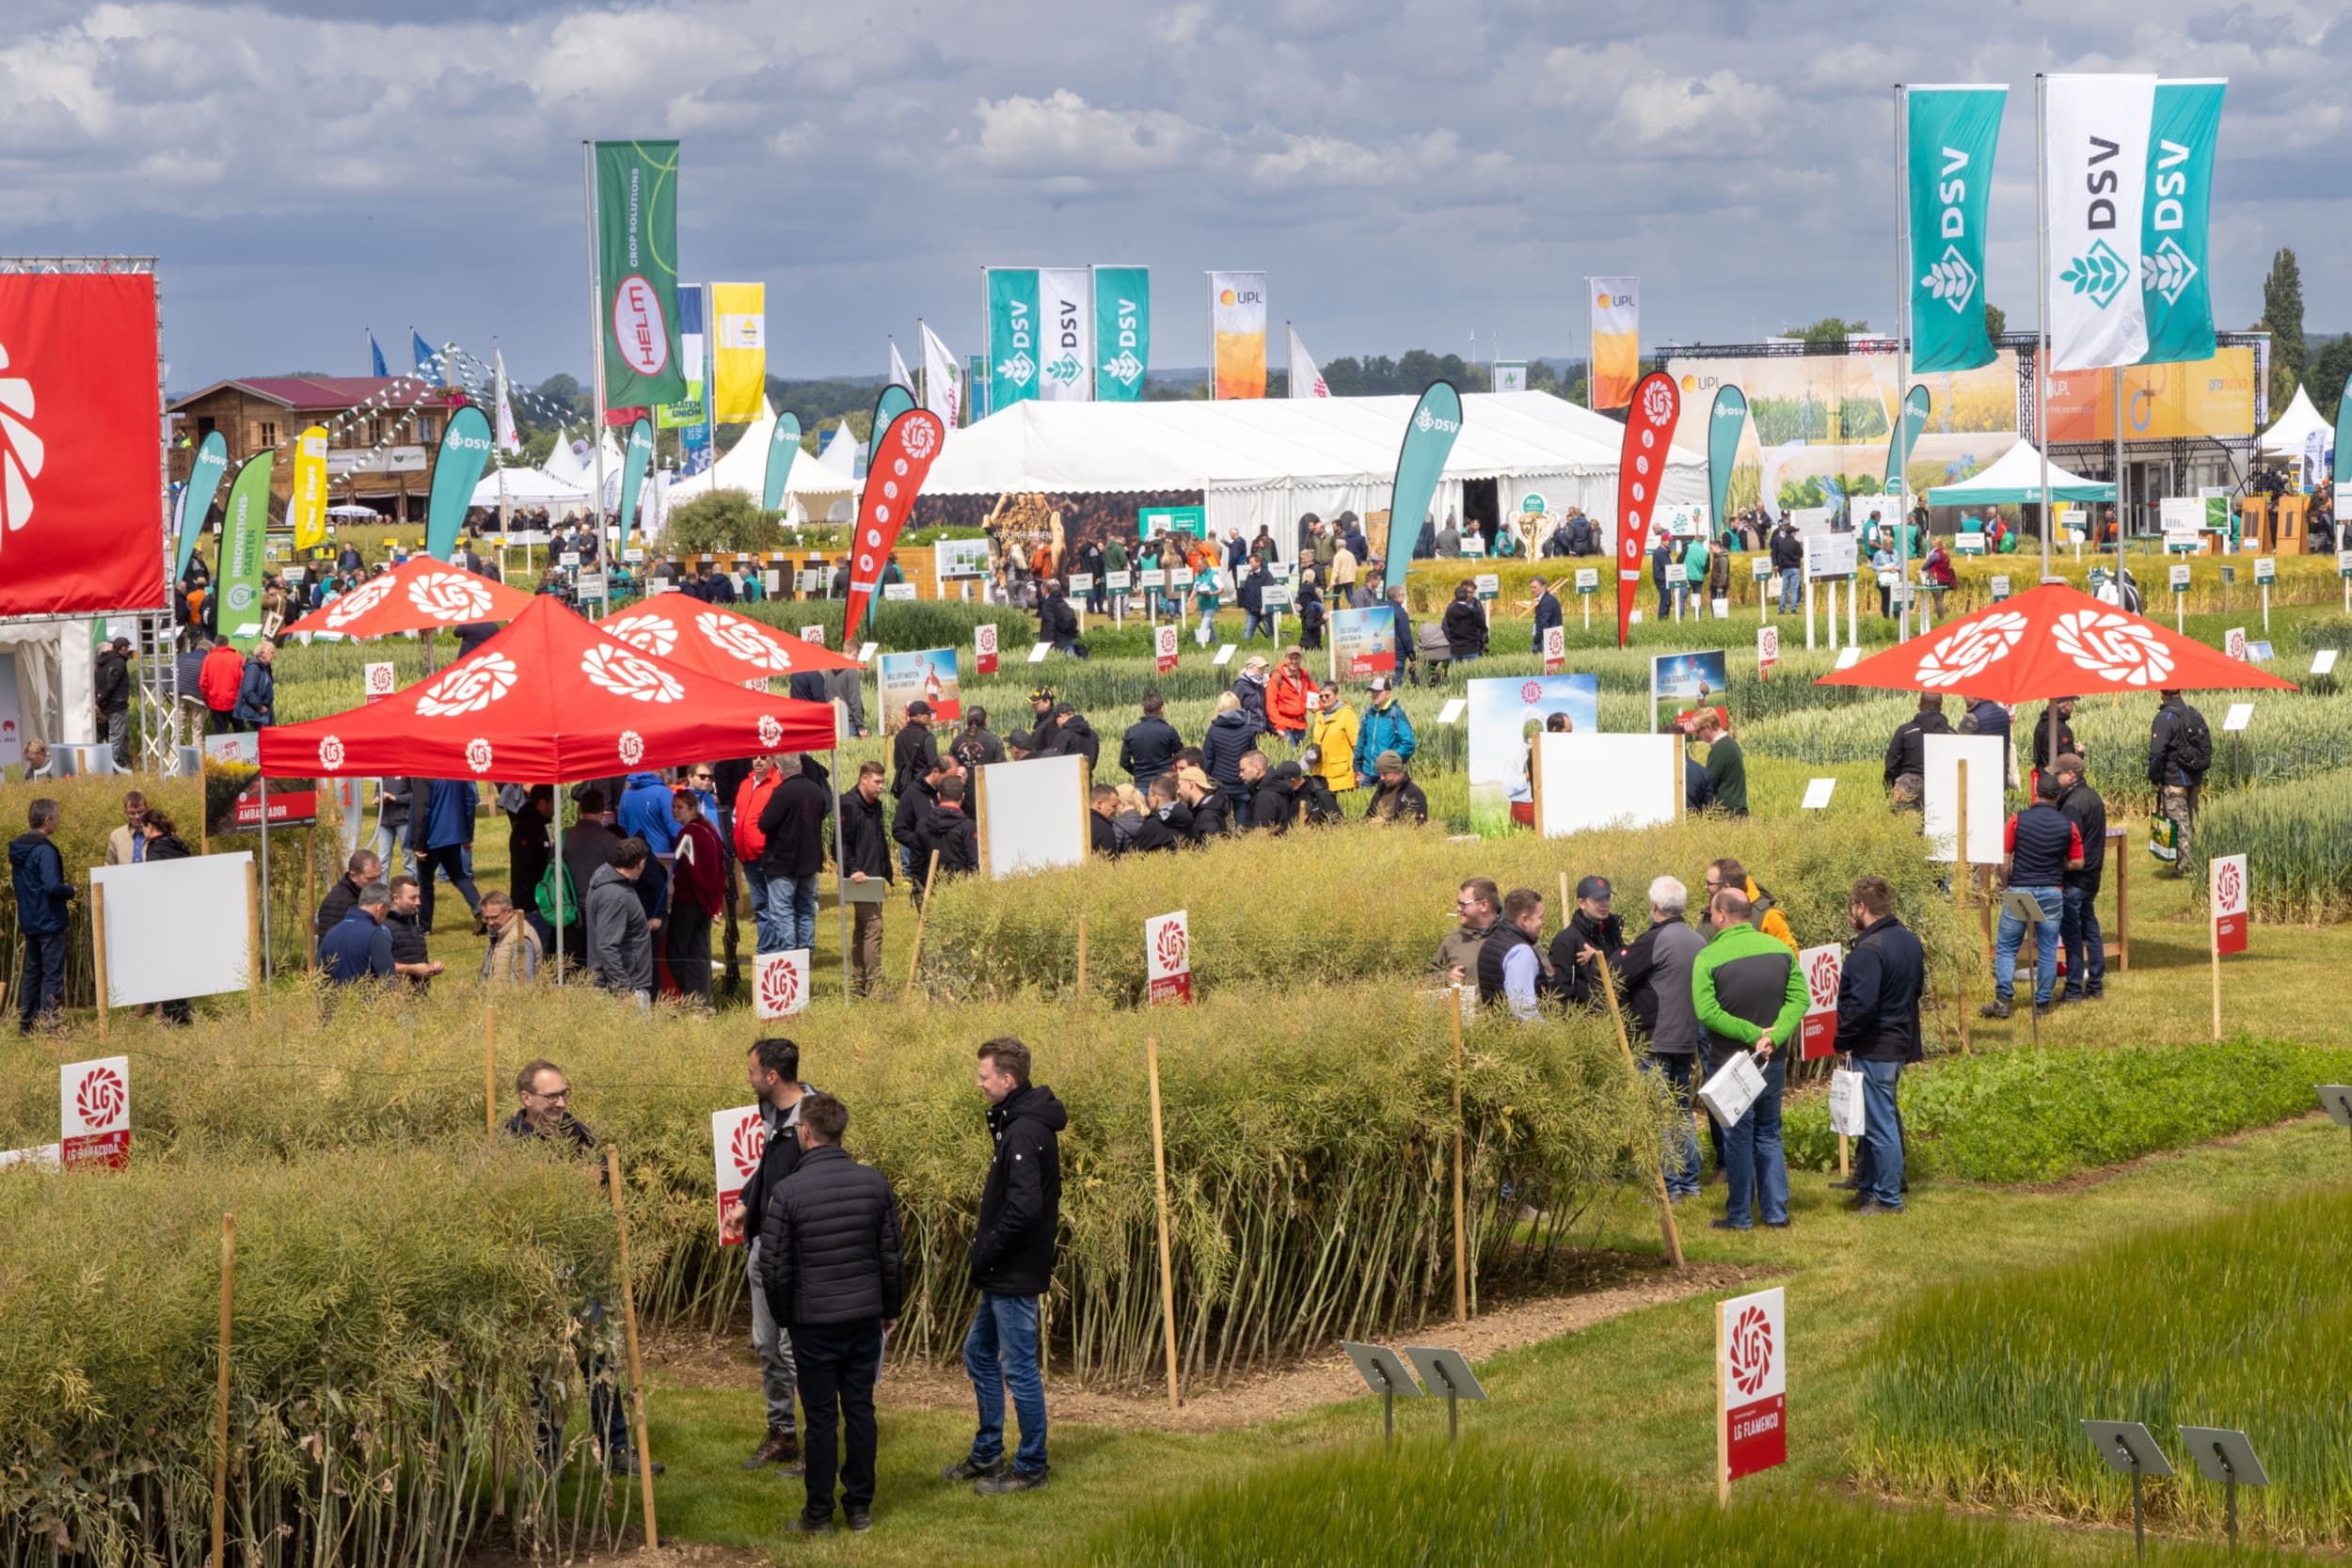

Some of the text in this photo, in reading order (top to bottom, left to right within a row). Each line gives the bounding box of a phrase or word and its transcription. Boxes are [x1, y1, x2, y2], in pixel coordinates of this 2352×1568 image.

[1939, 146, 1969, 239] DSV
[2087, 135, 2120, 230] DSV
[2154, 139, 2190, 231] DSV
[629, 167, 639, 268] CROP SOLUTIONS
[1237, 291, 1263, 305] UPL
[1613, 295, 1635, 308] UPL
[628, 285, 656, 366] HELM
[1010, 300, 1030, 349] DSV
[1060, 299, 1077, 348] DSV
[1119, 298, 1136, 347] DSV
[2054, 380, 2071, 396] UPL
[668, 400, 700, 409] SAATEN
[672, 408, 701, 418] UNION
[1652, 394, 1664, 412] LG
[1727, 405, 1746, 416] DSV
[1914, 406, 1929, 419] DSV
[1435, 418, 1459, 434] DSV
[464, 437, 490, 451] DSV
[912, 430, 925, 447] LG
[209, 453, 227, 466] DSV
[307, 505, 317, 531] Der
[232, 491, 248, 578] INNOVATIONS-
[244, 529, 257, 576] GARTEN
[430, 585, 469, 608] LG
[718, 627, 767, 653] LG
[1944, 631, 2001, 665] LG
[2084, 630, 2138, 662] LG
[378, 673, 386, 684] LG
[606, 659, 660, 687] LG
[440, 672, 491, 701] LG
[1527, 687, 1536, 697] LG
[766, 723, 776, 738] LG
[326, 745, 338, 760] LG
[473, 748, 485, 763] LG
[626, 740, 637, 754] LG
[239, 805, 287, 820] AMBASADOR
[2225, 876, 2233, 896] LG
[1166, 934, 1177, 957] LG
[773, 973, 787, 996] LG
[1820, 967, 1831, 991] LG
[92, 1084, 110, 1110] LG
[747, 1132, 765, 1161] LG
[1743, 1330, 1760, 1369] LG
[1734, 1424, 1742, 1442] LG
[1743, 1412, 1779, 1438] FLAMENCO
